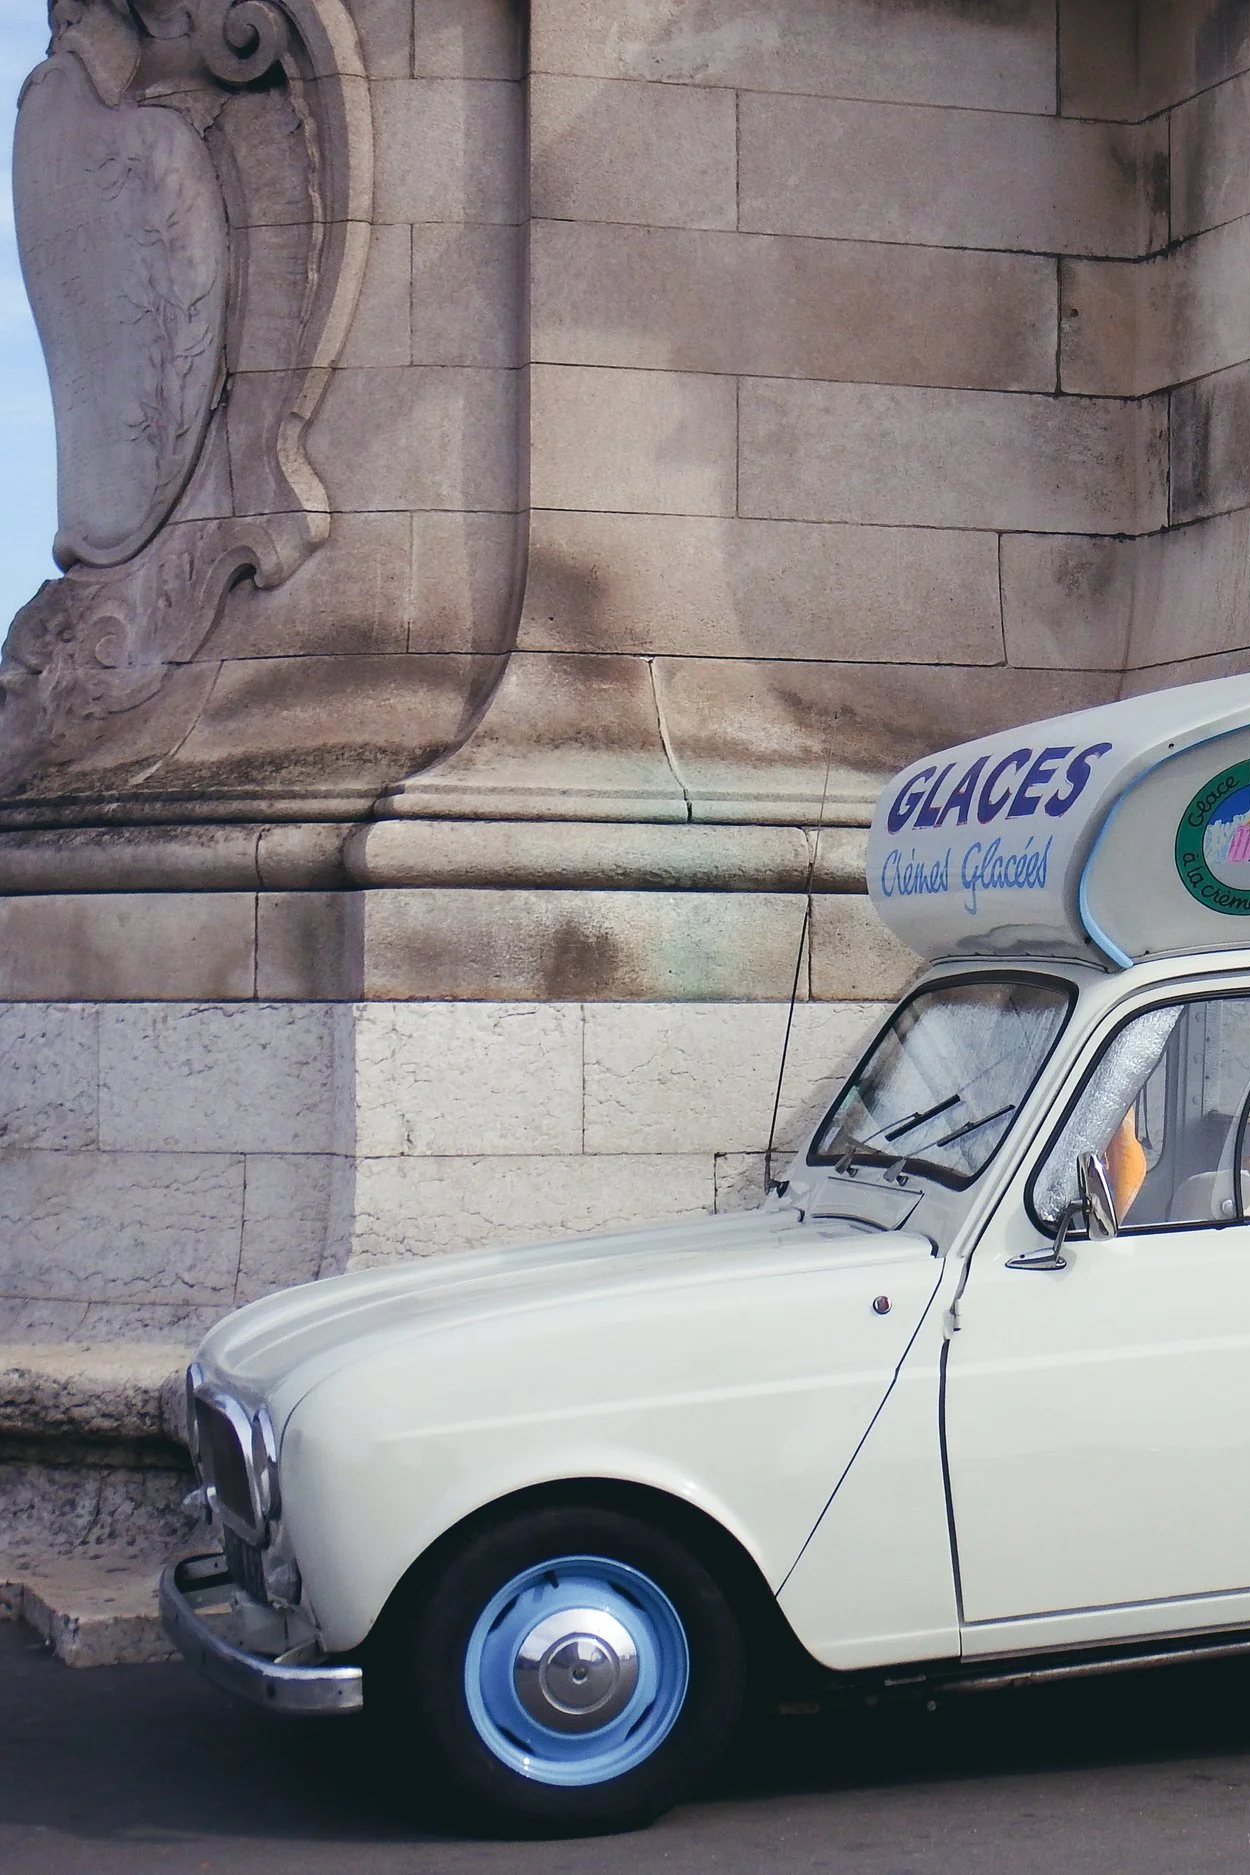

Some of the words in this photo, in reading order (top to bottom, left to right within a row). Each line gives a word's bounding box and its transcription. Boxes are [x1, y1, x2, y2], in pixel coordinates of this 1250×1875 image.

[886, 742, 1113, 835] GLACES
[1188, 775, 1240, 828] Glace
[961, 835, 1054, 915] Glacées
[1186, 866, 1205, 889] la
